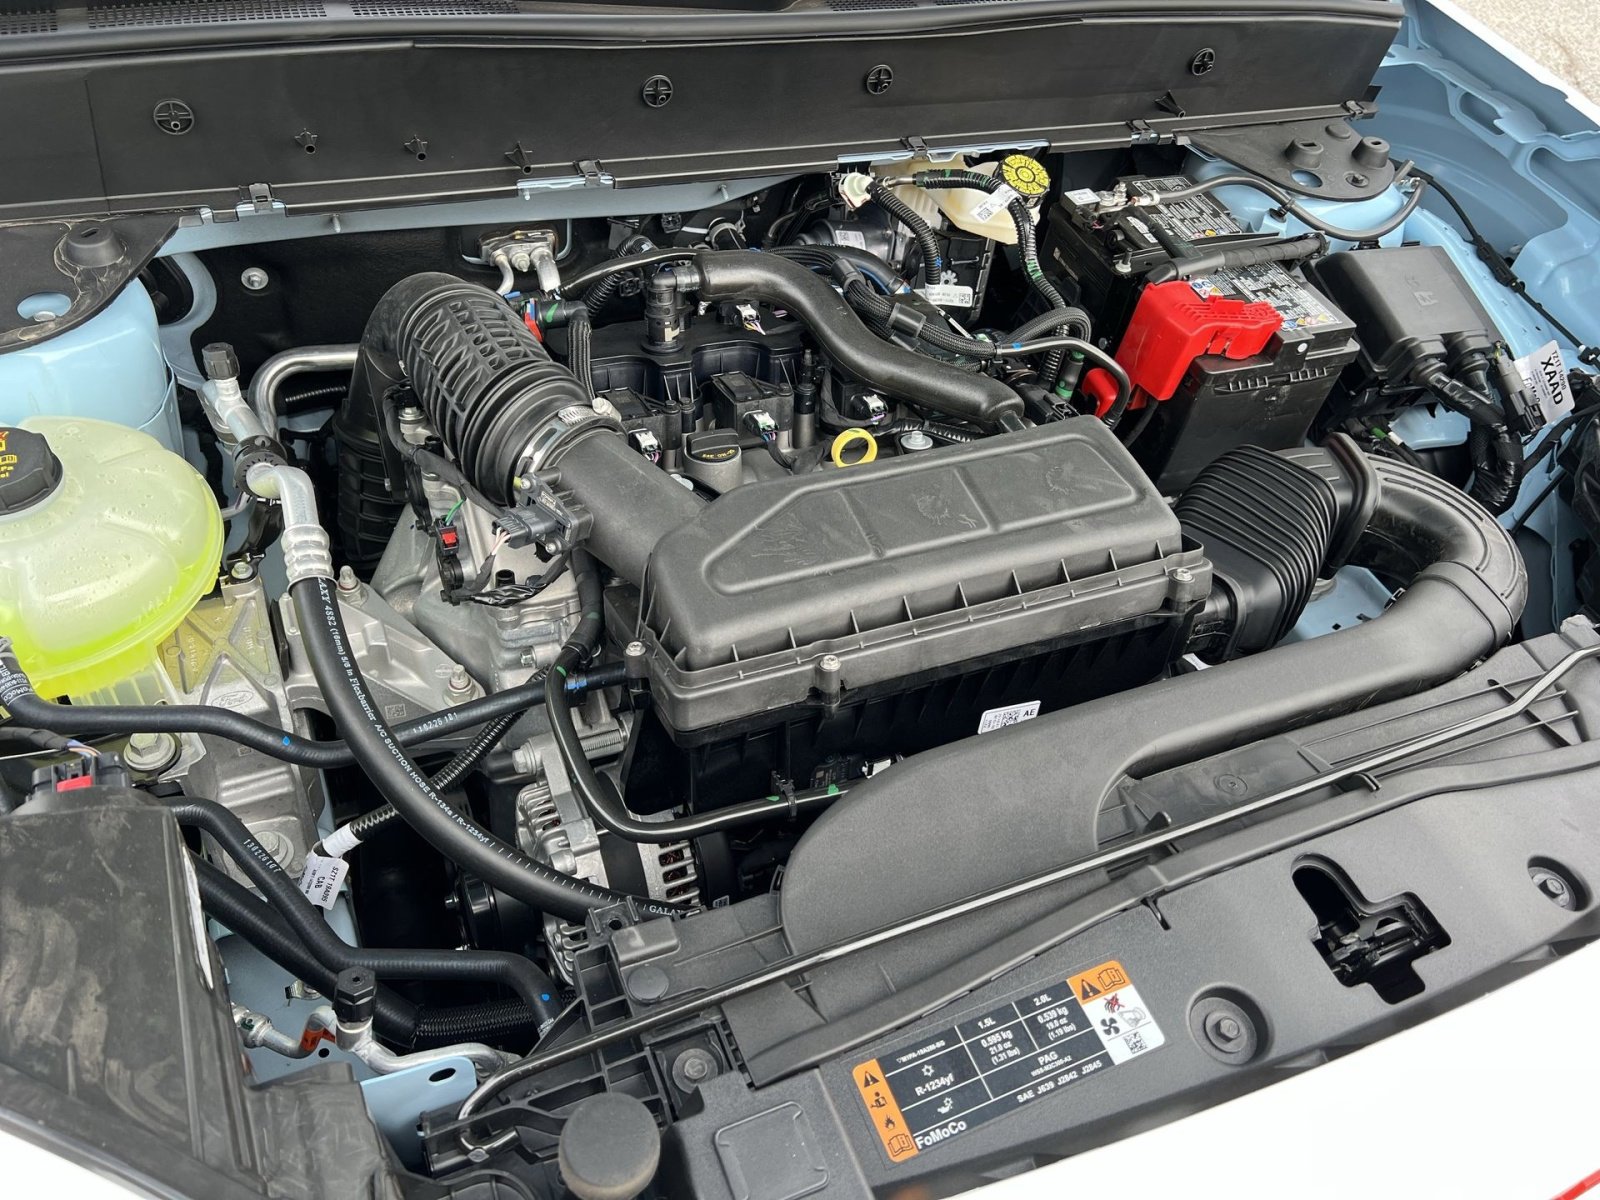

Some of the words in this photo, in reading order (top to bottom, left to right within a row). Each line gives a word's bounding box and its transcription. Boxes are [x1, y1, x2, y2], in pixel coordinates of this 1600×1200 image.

[1540, 356, 1564, 405] XAAD
[1023, 708, 1036, 718] AE
[324, 605, 337, 627] 4882
[349, 677, 377, 721] Flexbarrier
[374, 723, 387, 738] A/C
[384, 738, 413, 771] SUCTION
[409, 771, 431, 793] HOSE
[428, 791, 454, 816] R-134a
[456, 817, 490, 843] R-1234yf
[314, 876, 326, 889] CAB
[649, 905, 685, 916] GALA
[1033, 994, 1052, 1007] 2.0L
[977, 1017, 996, 1030] 1.5L
[1037, 1010, 1055, 1024] 0.539
[1055, 1006, 1068, 1018] kg
[981, 1034, 1000, 1048] 0.595
[999, 1030, 1014, 1043] kg
[1037, 1050, 1059, 1065] PAG
[915, 1073, 954, 1096] R-1234yf
[1016, 1089, 1035, 1104] SAE
[1036, 1081, 1056, 1096] J639
[1057, 1071, 1078, 1087] J2842
[915, 1119, 967, 1149] FoMoCo
